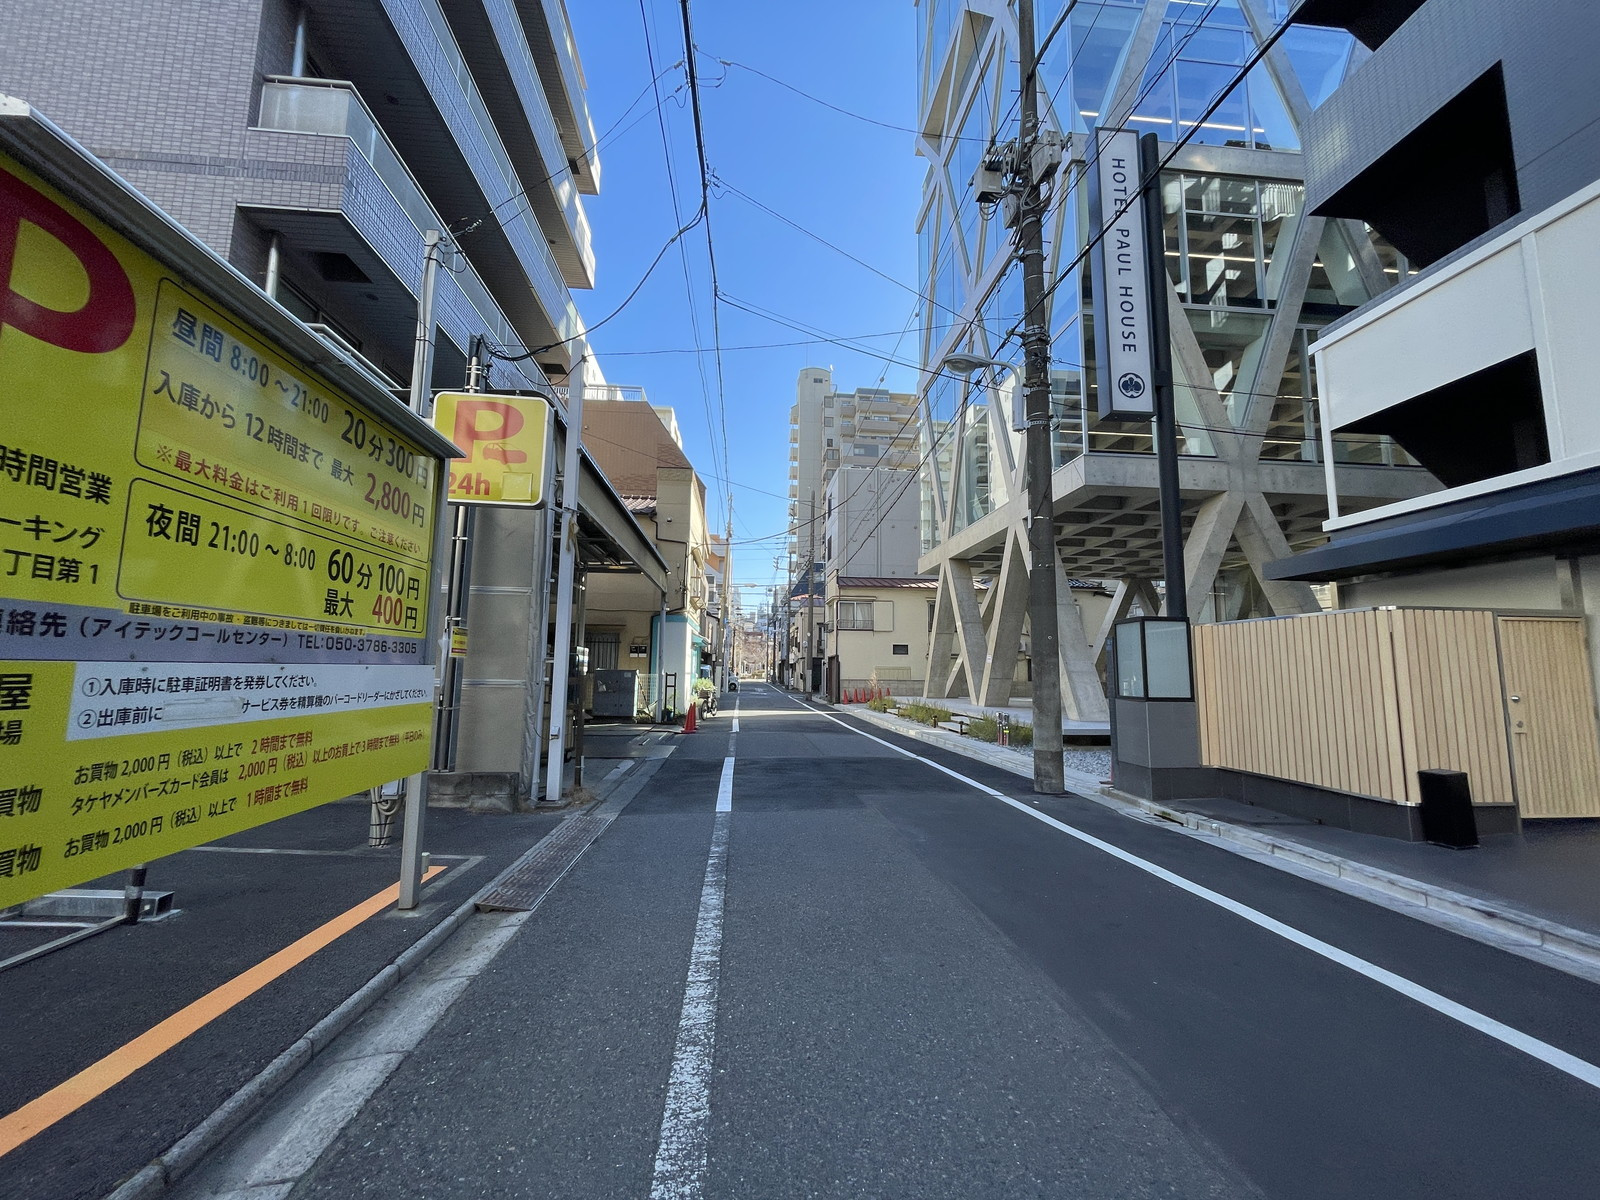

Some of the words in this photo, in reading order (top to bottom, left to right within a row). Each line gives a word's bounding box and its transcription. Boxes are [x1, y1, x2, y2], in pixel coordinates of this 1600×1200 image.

[1112, 158, 1128, 217] HOTEL
[1116, 228, 1130, 276] PAUL
[172, 307, 223, 362] 昼間
[1119, 286, 1137, 353] HOUSE
[153, 369, 237, 429] 入庫から
[451, 400, 524, 464] P
[0, 444, 113, 505] 時間営業
[448, 472, 490, 496] 24h
[145, 502, 200, 547] 夜間
[323, 588, 354, 618] 最大
[371, 593, 419, 630] 400円
[298, 634, 418, 655] TEL:050-3786-3305
